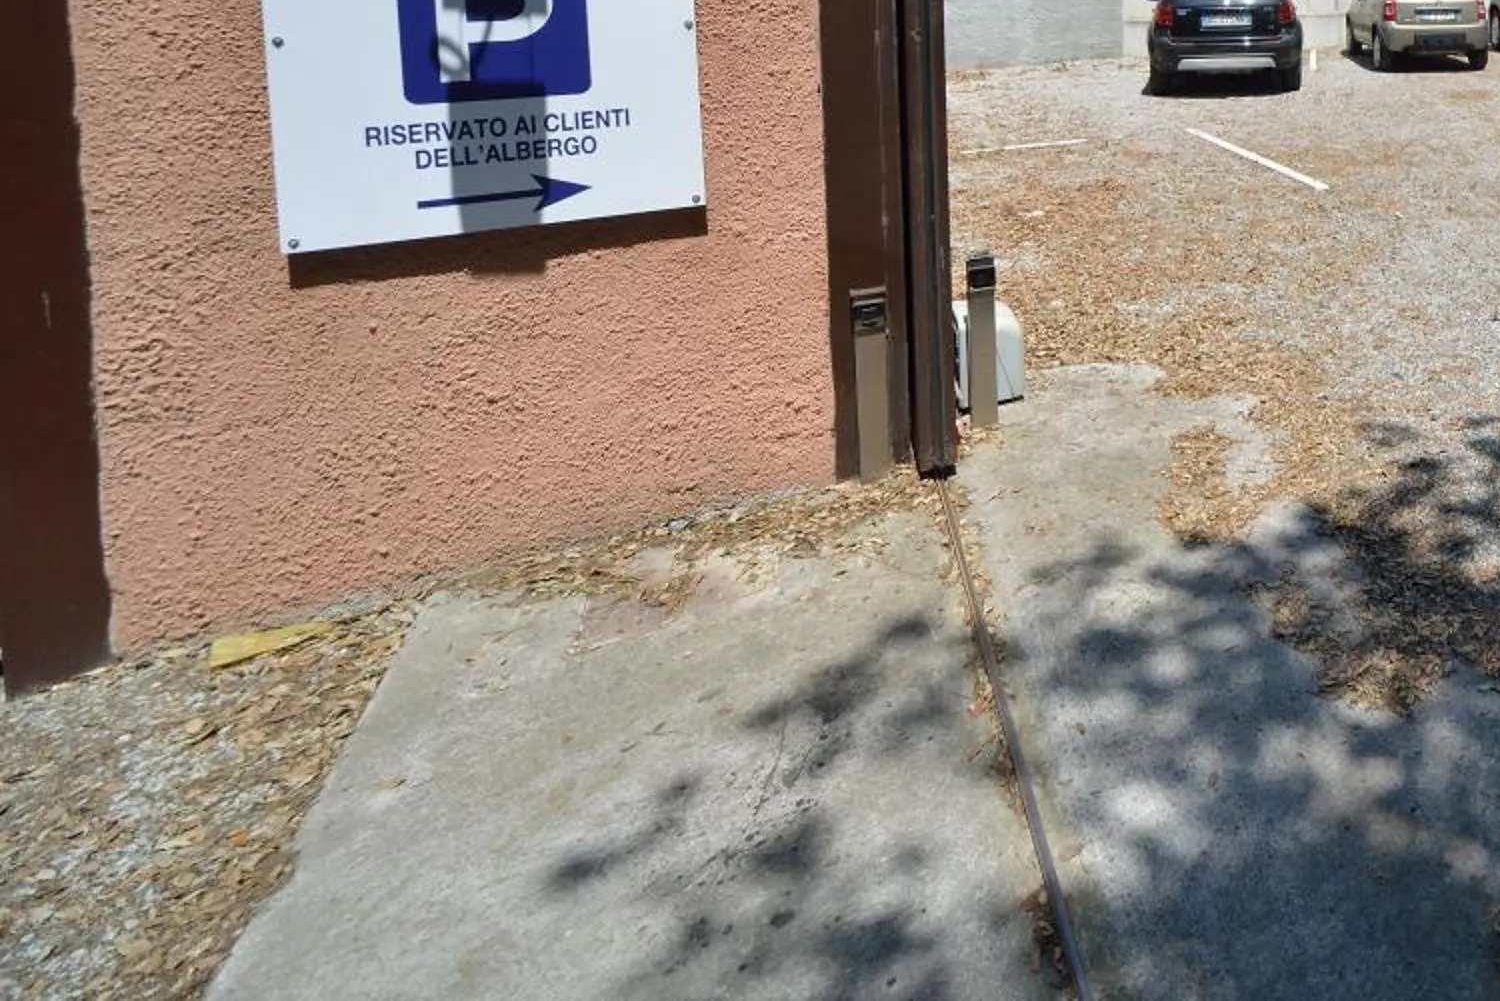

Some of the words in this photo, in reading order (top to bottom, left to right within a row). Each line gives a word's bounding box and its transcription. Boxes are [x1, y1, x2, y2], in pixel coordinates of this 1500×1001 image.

[365, 117, 507, 147] RISERVATO
[514, 114, 537, 136] AI
[543, 108, 631, 132] CLIENTI
[415, 135, 598, 170] DELL'ALBERGO
